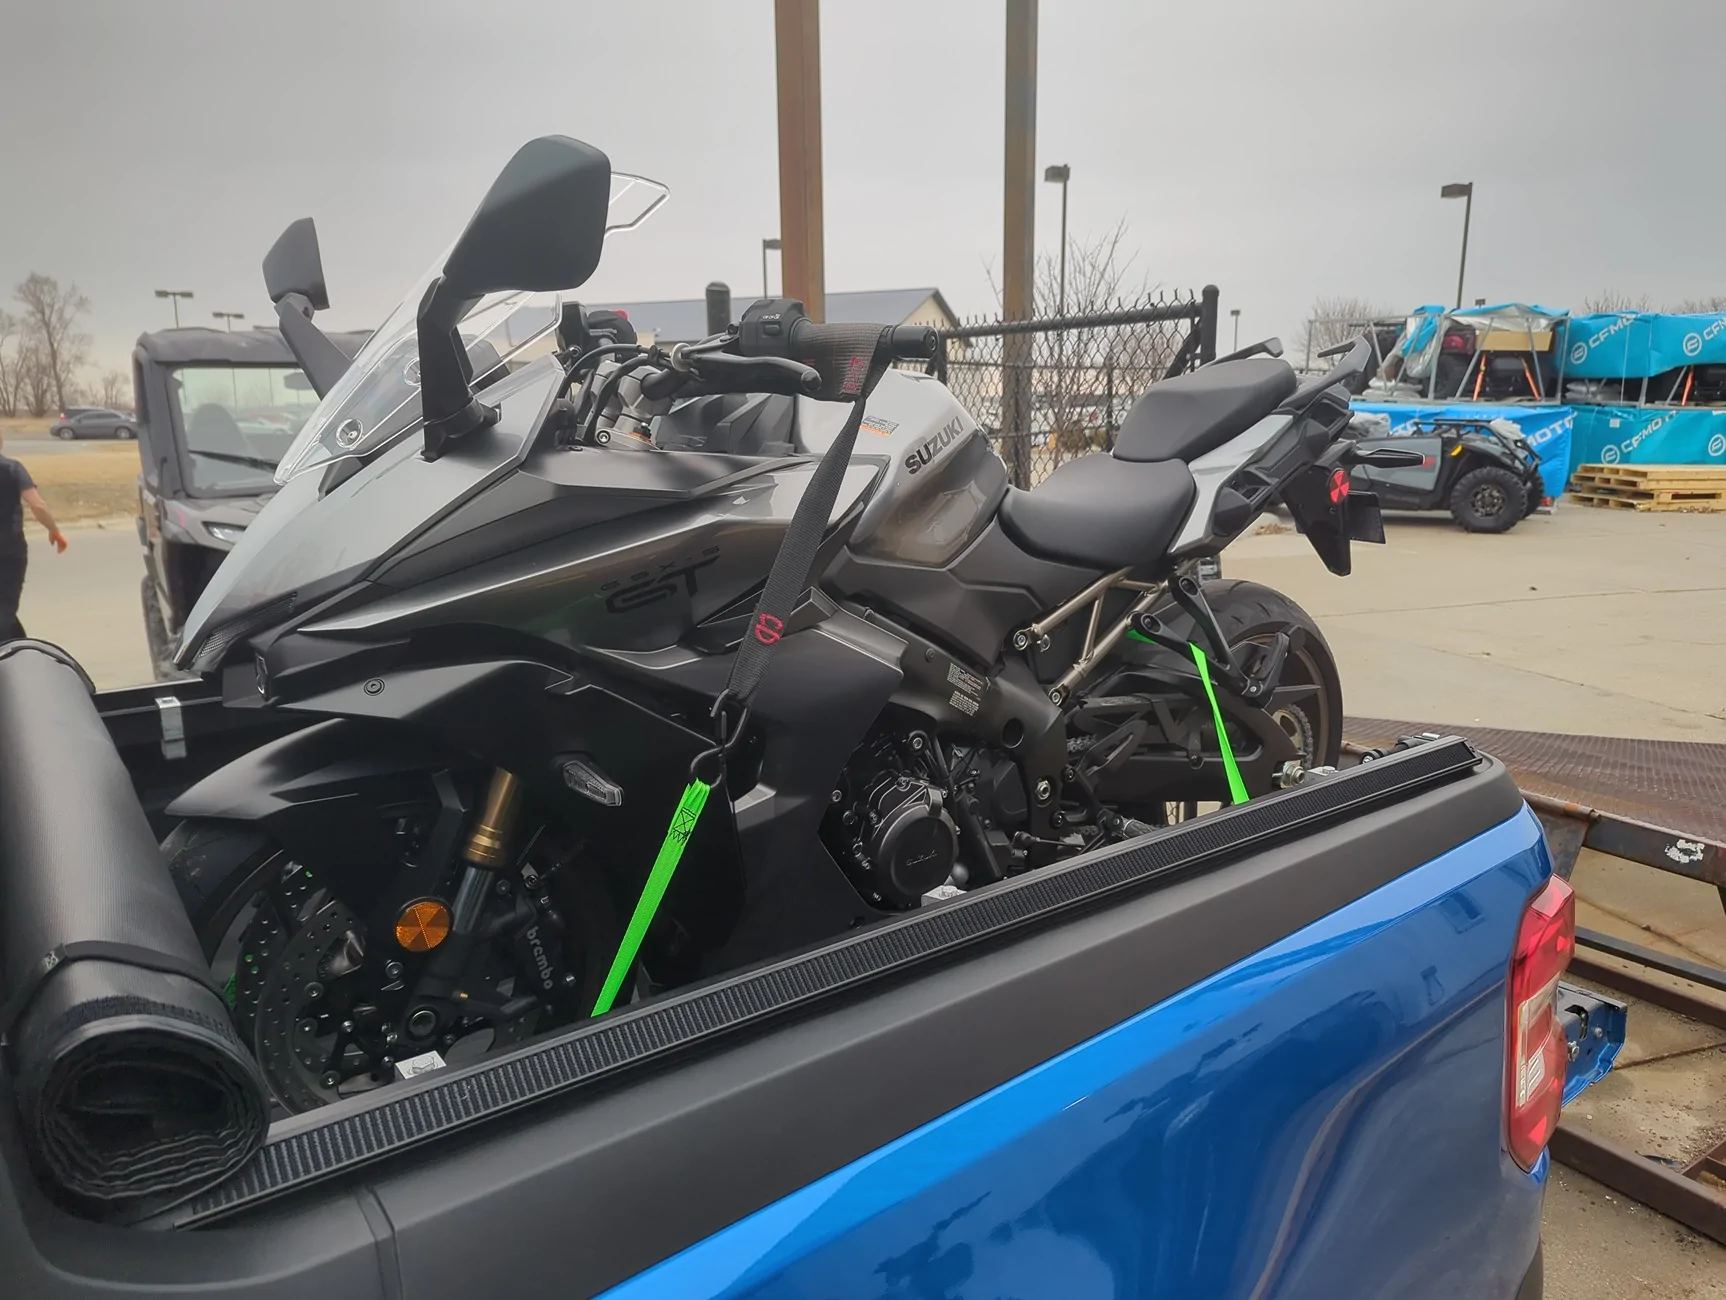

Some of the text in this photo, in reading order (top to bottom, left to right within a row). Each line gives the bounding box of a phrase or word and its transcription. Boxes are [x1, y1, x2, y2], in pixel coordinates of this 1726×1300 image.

[905, 416, 964, 475] SUZUKI
[605, 555, 720, 614] GT
[526, 926, 554, 990] brembo
